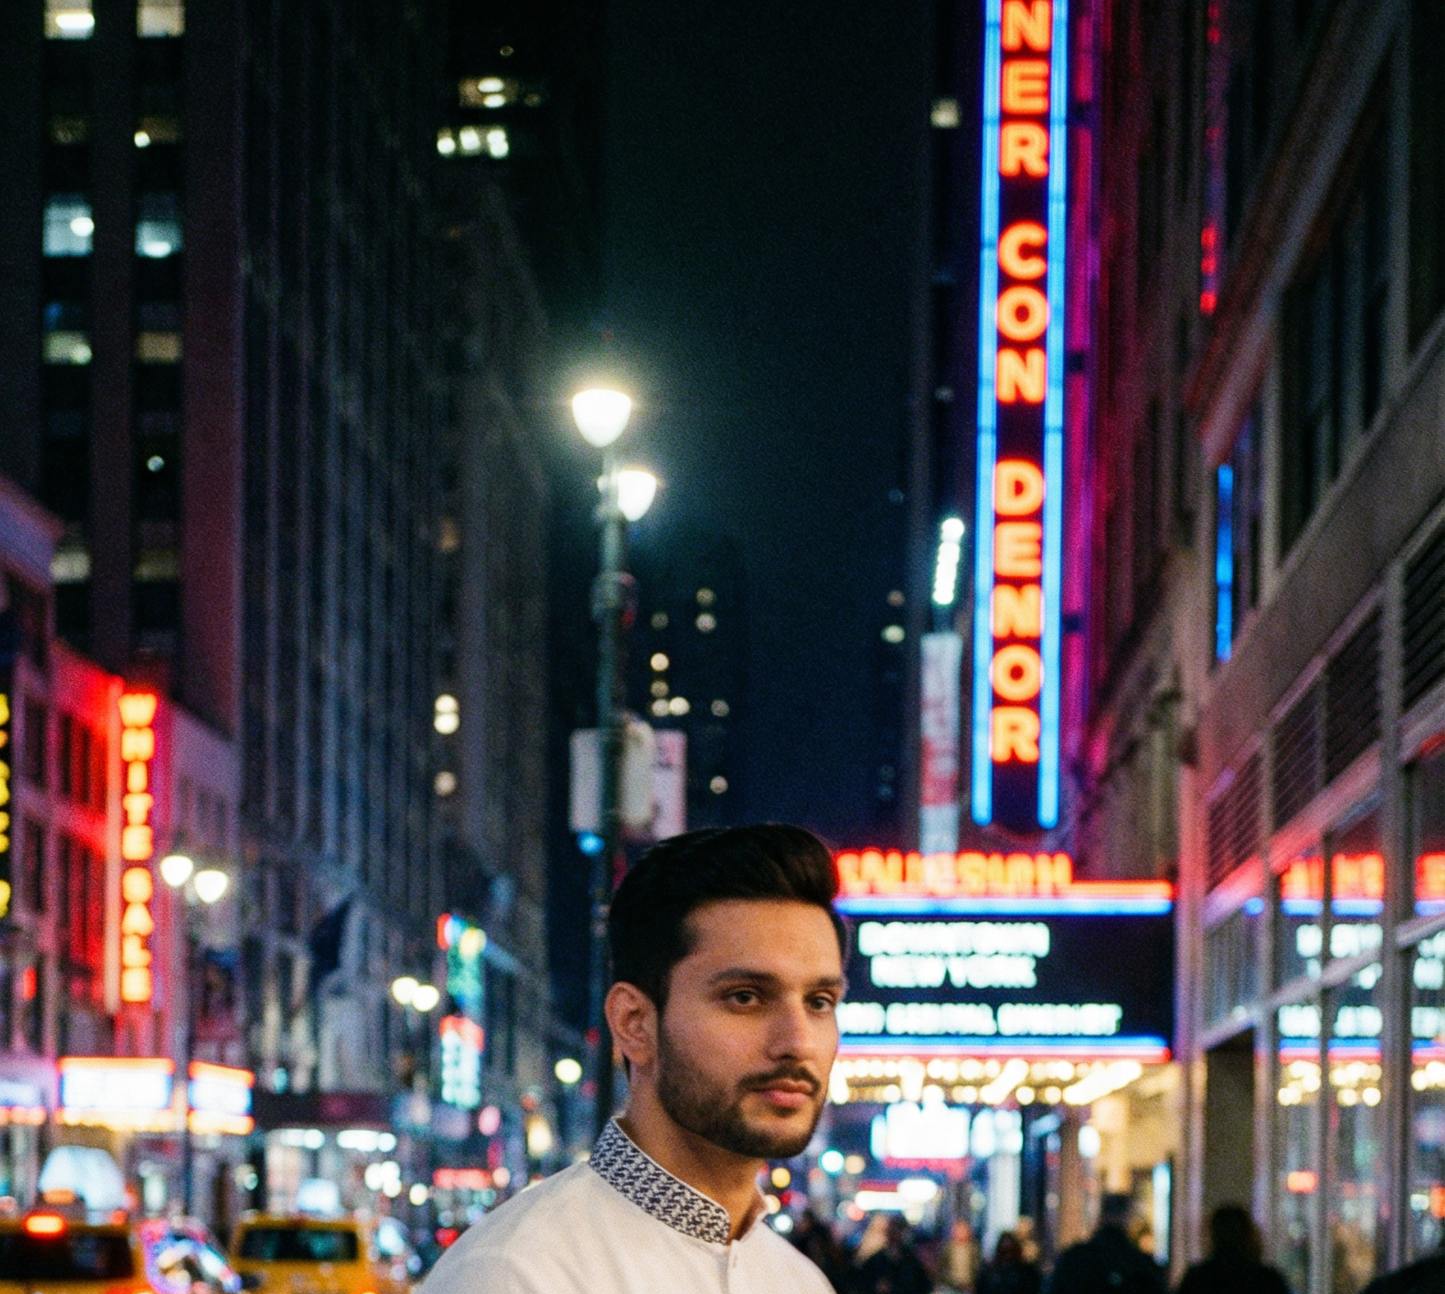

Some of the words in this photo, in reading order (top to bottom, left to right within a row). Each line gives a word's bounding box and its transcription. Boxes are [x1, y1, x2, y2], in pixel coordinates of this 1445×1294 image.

[999, 0, 1052, 178] NER
[995, 220, 1050, 405] CON
[989, 458, 1045, 763] DENOR
